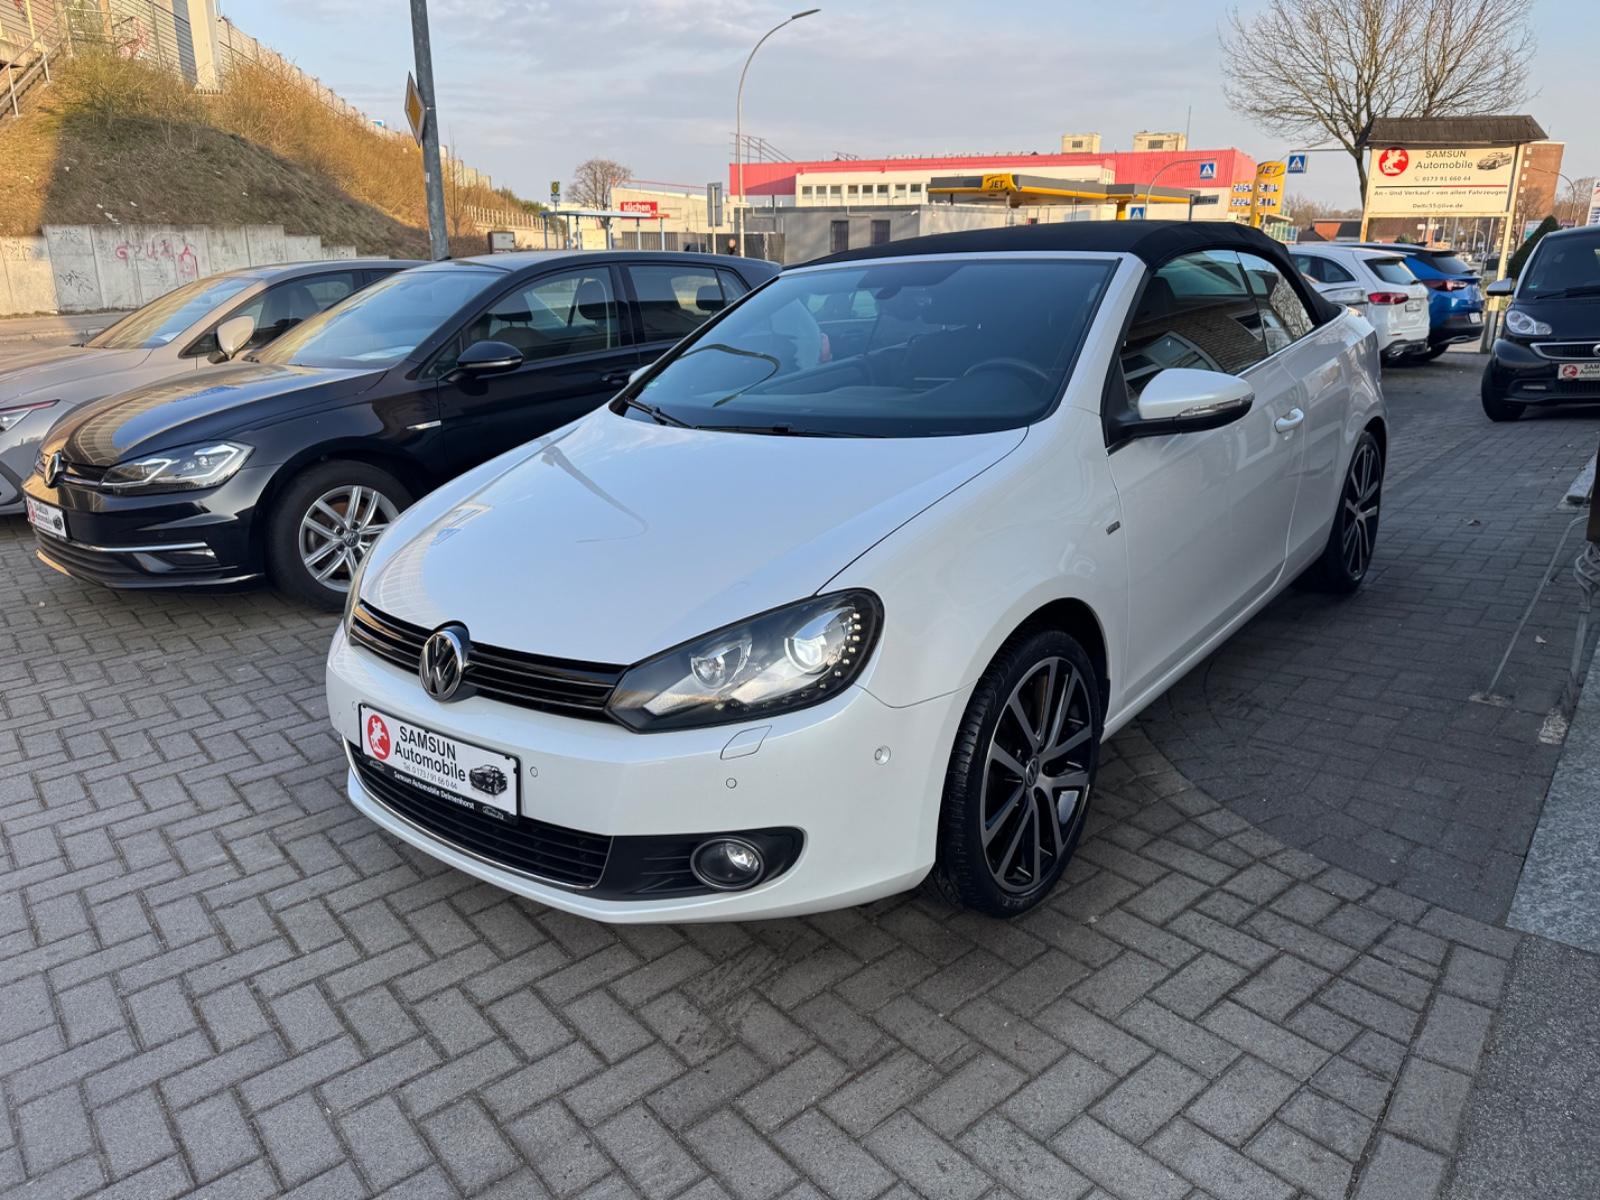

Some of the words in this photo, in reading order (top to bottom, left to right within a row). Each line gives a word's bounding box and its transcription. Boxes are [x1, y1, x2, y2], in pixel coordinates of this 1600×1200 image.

[1425, 150, 1466, 158] SAMSUN
[1258, 166, 1280, 175] JET
[1415, 160, 1473, 169] Automobile
[400, 726, 456, 761] SAMSUN
[395, 741, 466, 782] Automobile
[412, 778, 441, 796] Automobile
[440, 789, 475, 810] Delmenhorst
